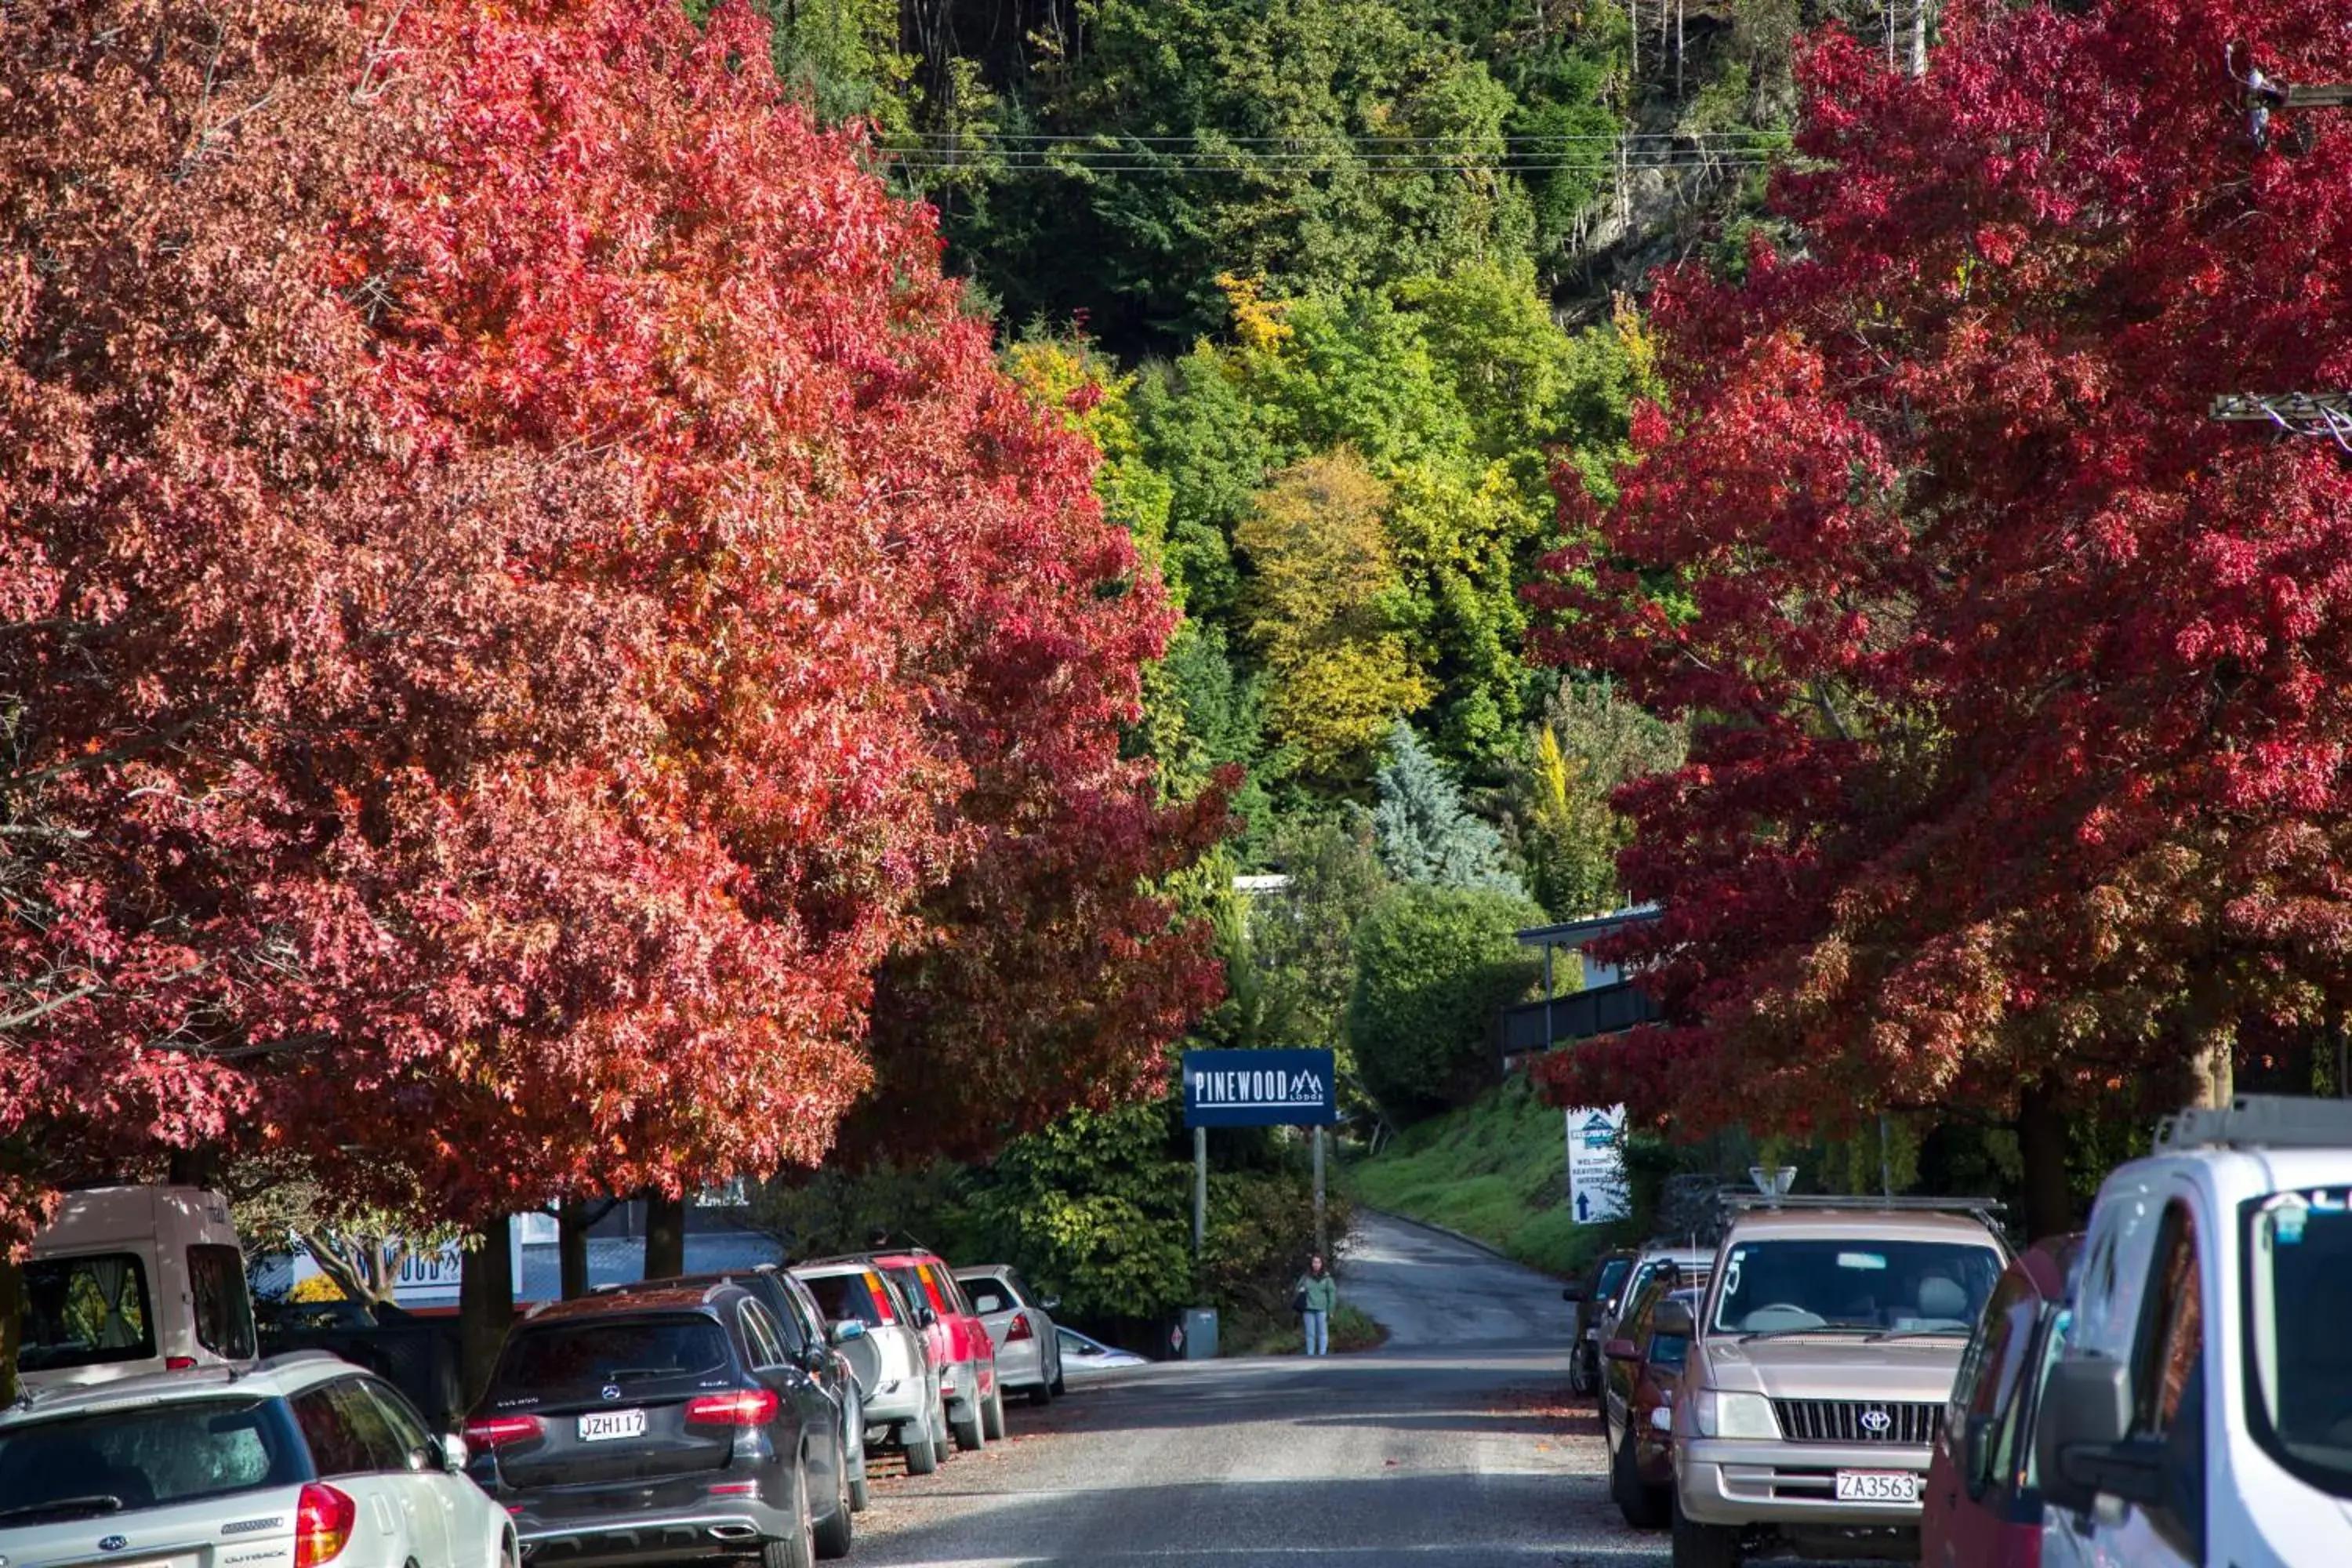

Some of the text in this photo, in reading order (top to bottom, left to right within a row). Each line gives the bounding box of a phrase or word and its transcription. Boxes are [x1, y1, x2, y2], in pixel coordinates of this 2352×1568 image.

[1195, 1070, 1287, 1102] PINEWOOD
[582, 1414, 644, 1436] JZH117
[1840, 1475, 1915, 1498] ZA3563
[224, 1549, 288, 1564] OUTBACK
